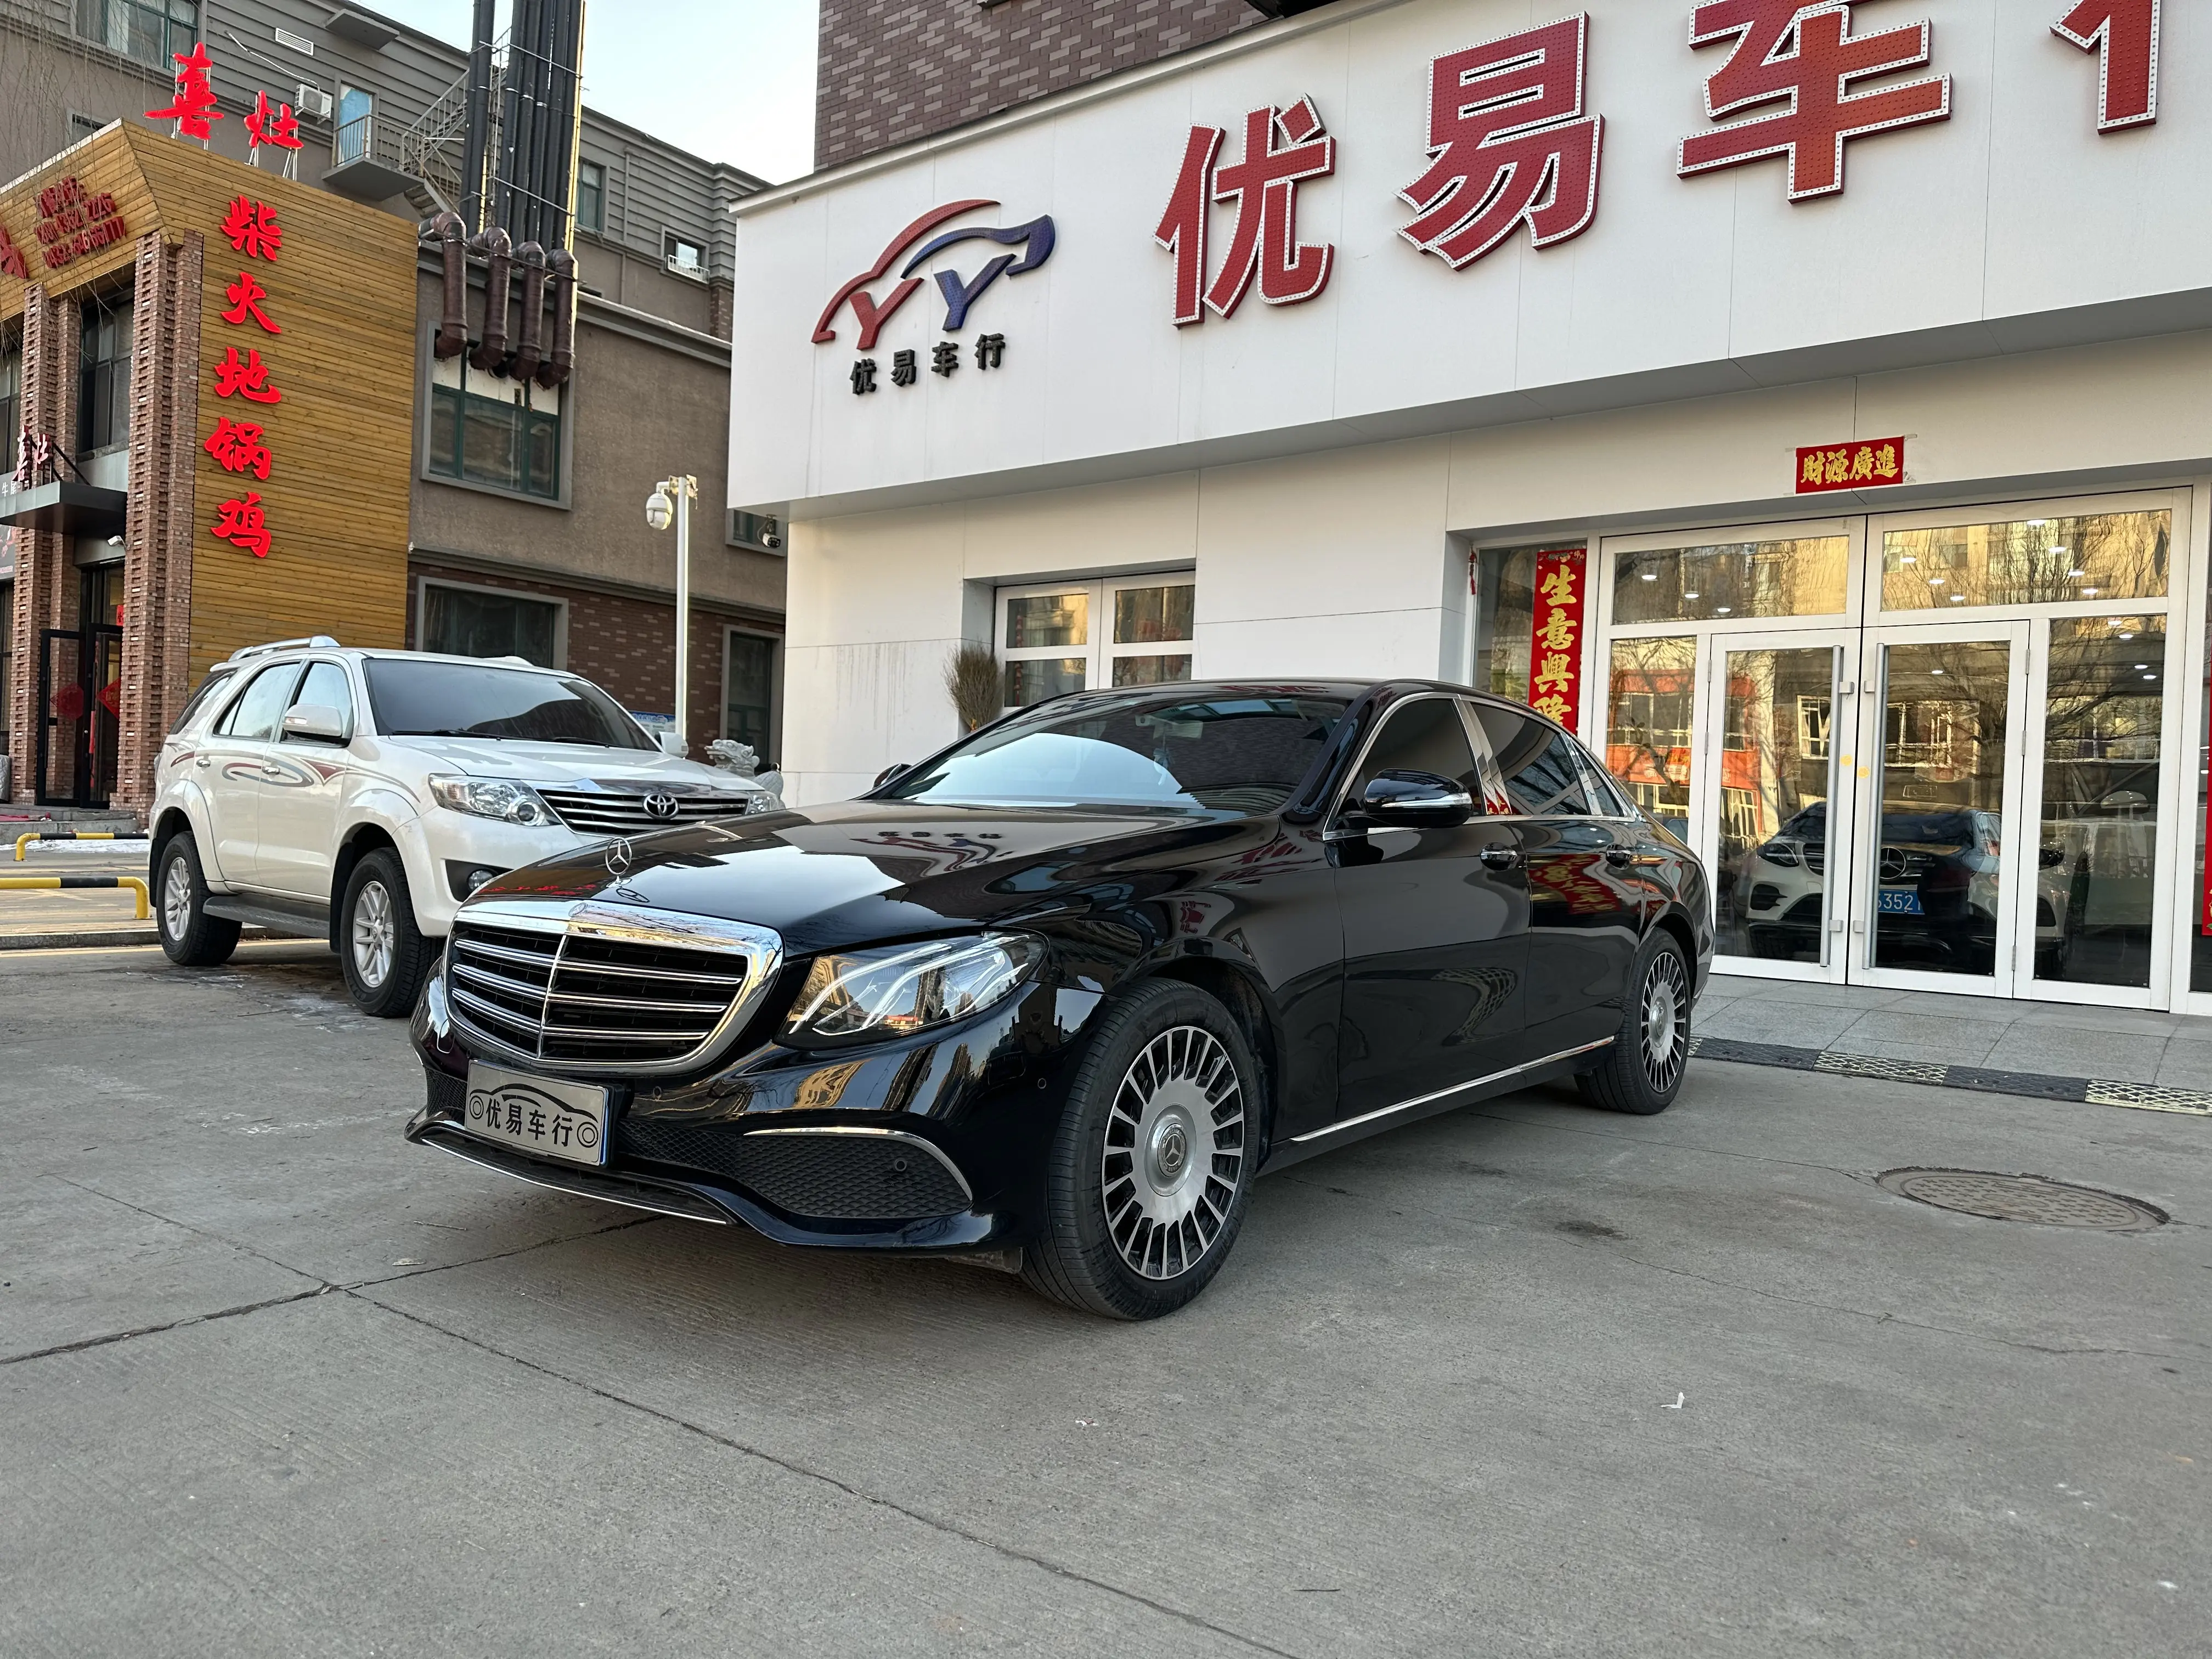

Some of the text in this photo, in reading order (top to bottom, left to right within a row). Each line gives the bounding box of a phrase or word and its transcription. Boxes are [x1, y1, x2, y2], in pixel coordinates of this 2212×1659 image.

[143, 41, 304, 149] 喜灶
[204, 195, 283, 558] 柴火地锅鸡
[849, 332, 1006, 396] 优易车行
[1800, 443, 1899, 486] 財源廣進
[486, 1097, 573, 1147] 优易车行
